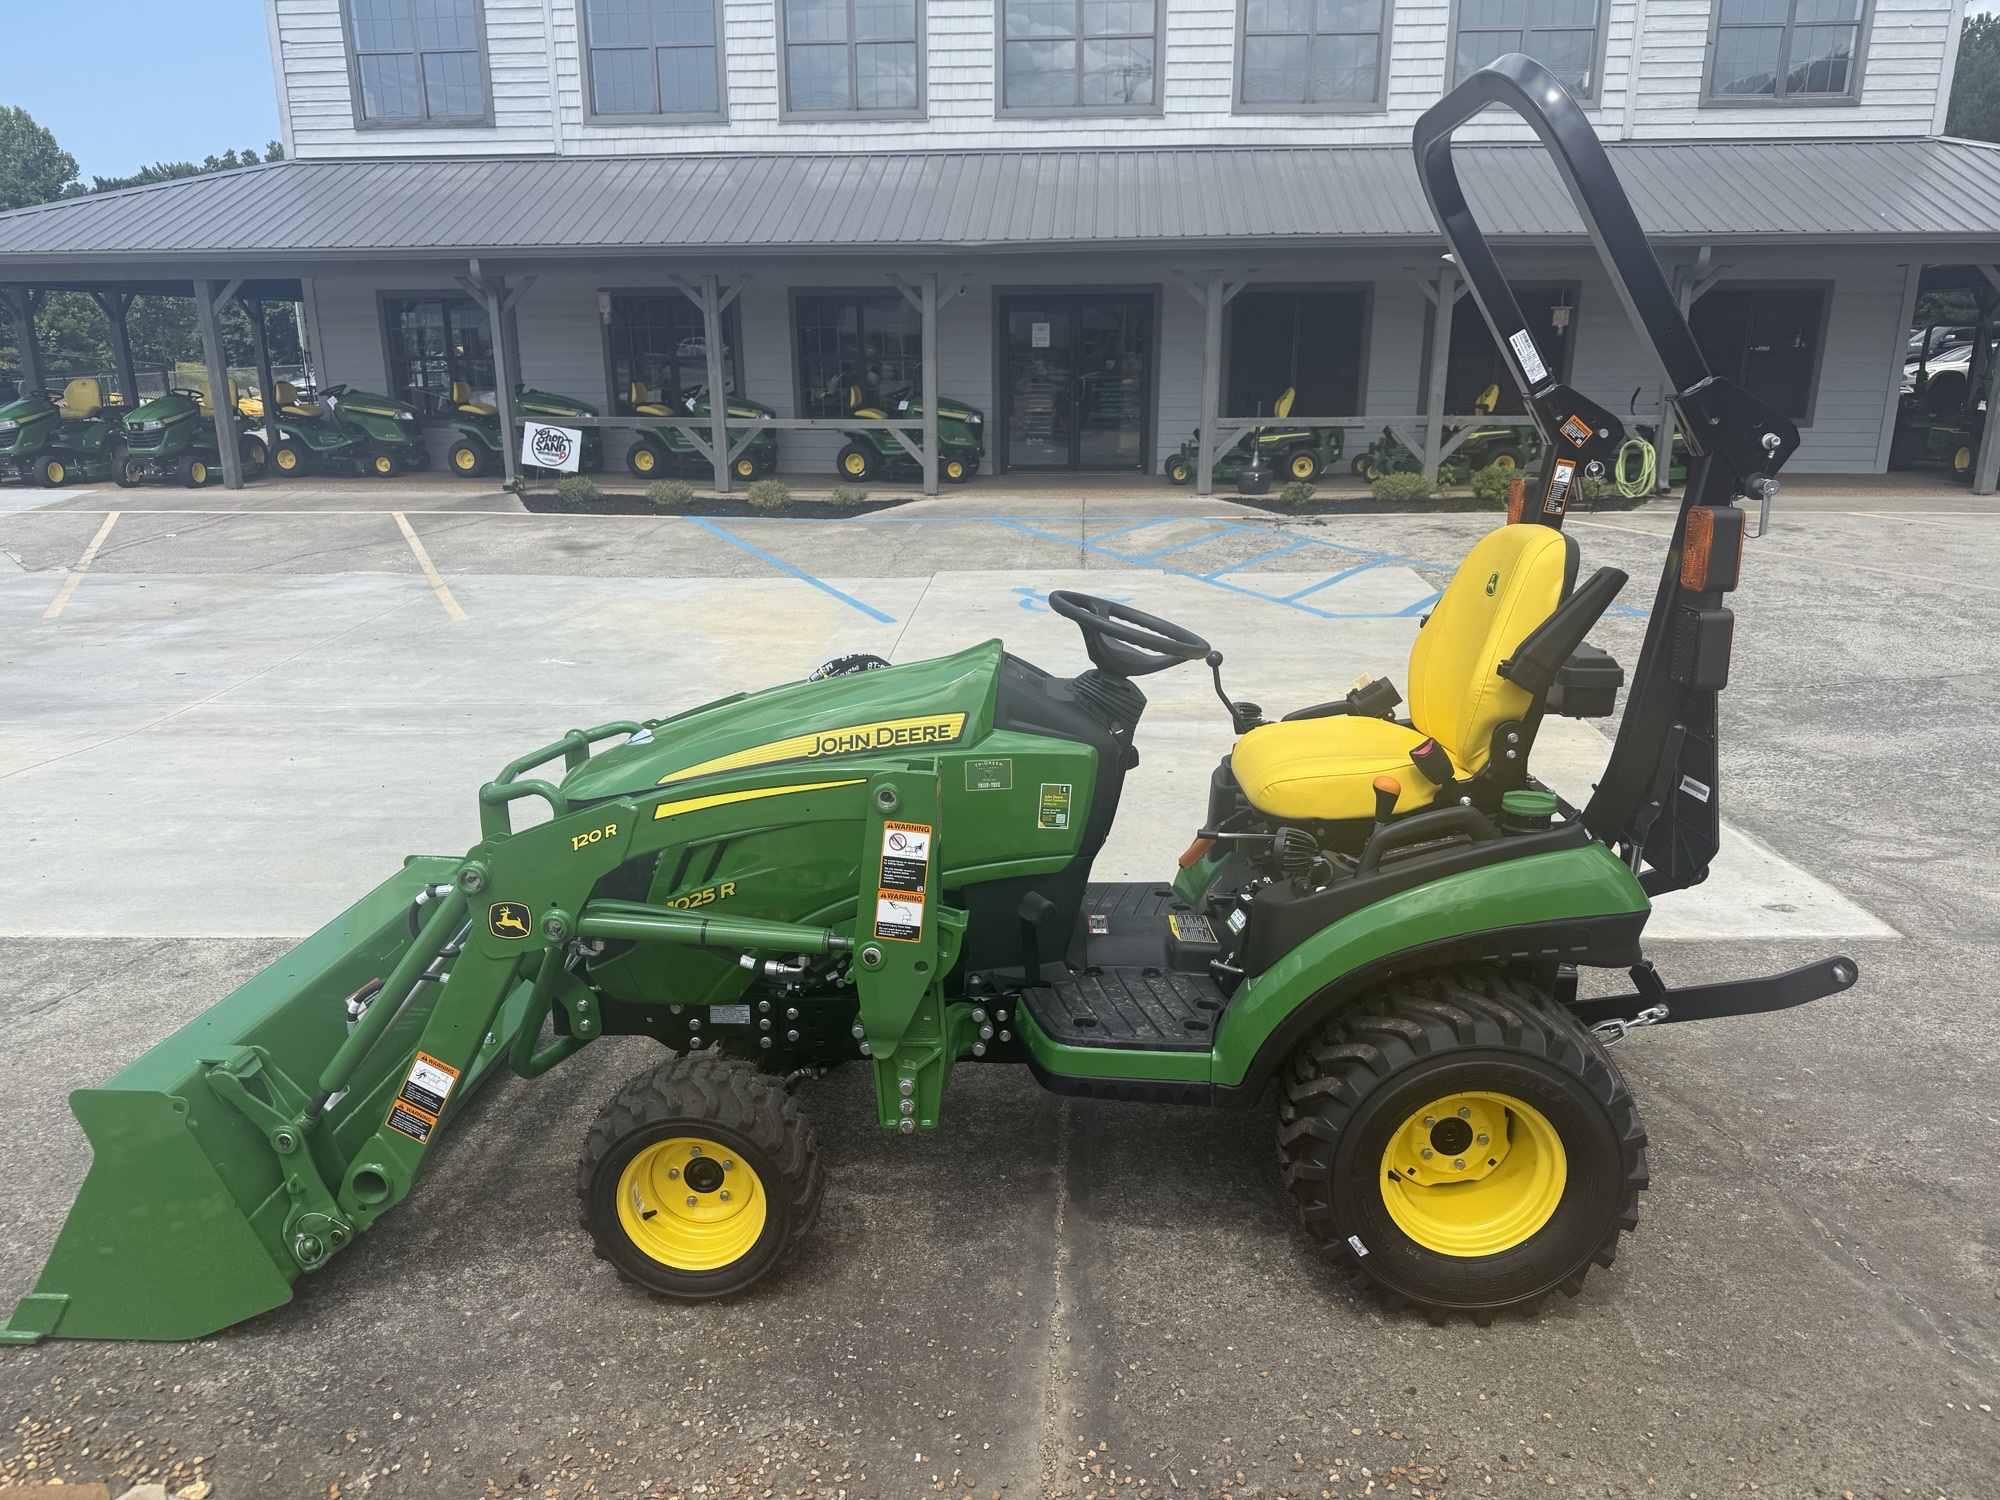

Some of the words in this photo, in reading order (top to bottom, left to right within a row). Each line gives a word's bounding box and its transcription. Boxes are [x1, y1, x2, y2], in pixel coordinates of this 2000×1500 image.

[535, 429, 573, 445] Shop
[535, 442, 566, 452] SAND
[807, 732, 871, 757] JOHN
[876, 723, 952, 748] DEERE
[894, 823, 930, 833] WARNING
[571, 829, 603, 852] 120
[605, 823, 619, 839] R
[720, 881, 737, 899] R
[887, 893, 923, 903] WARNING
[427, 1058, 455, 1075] WARNING
[406, 1106, 432, 1123] WARNING
